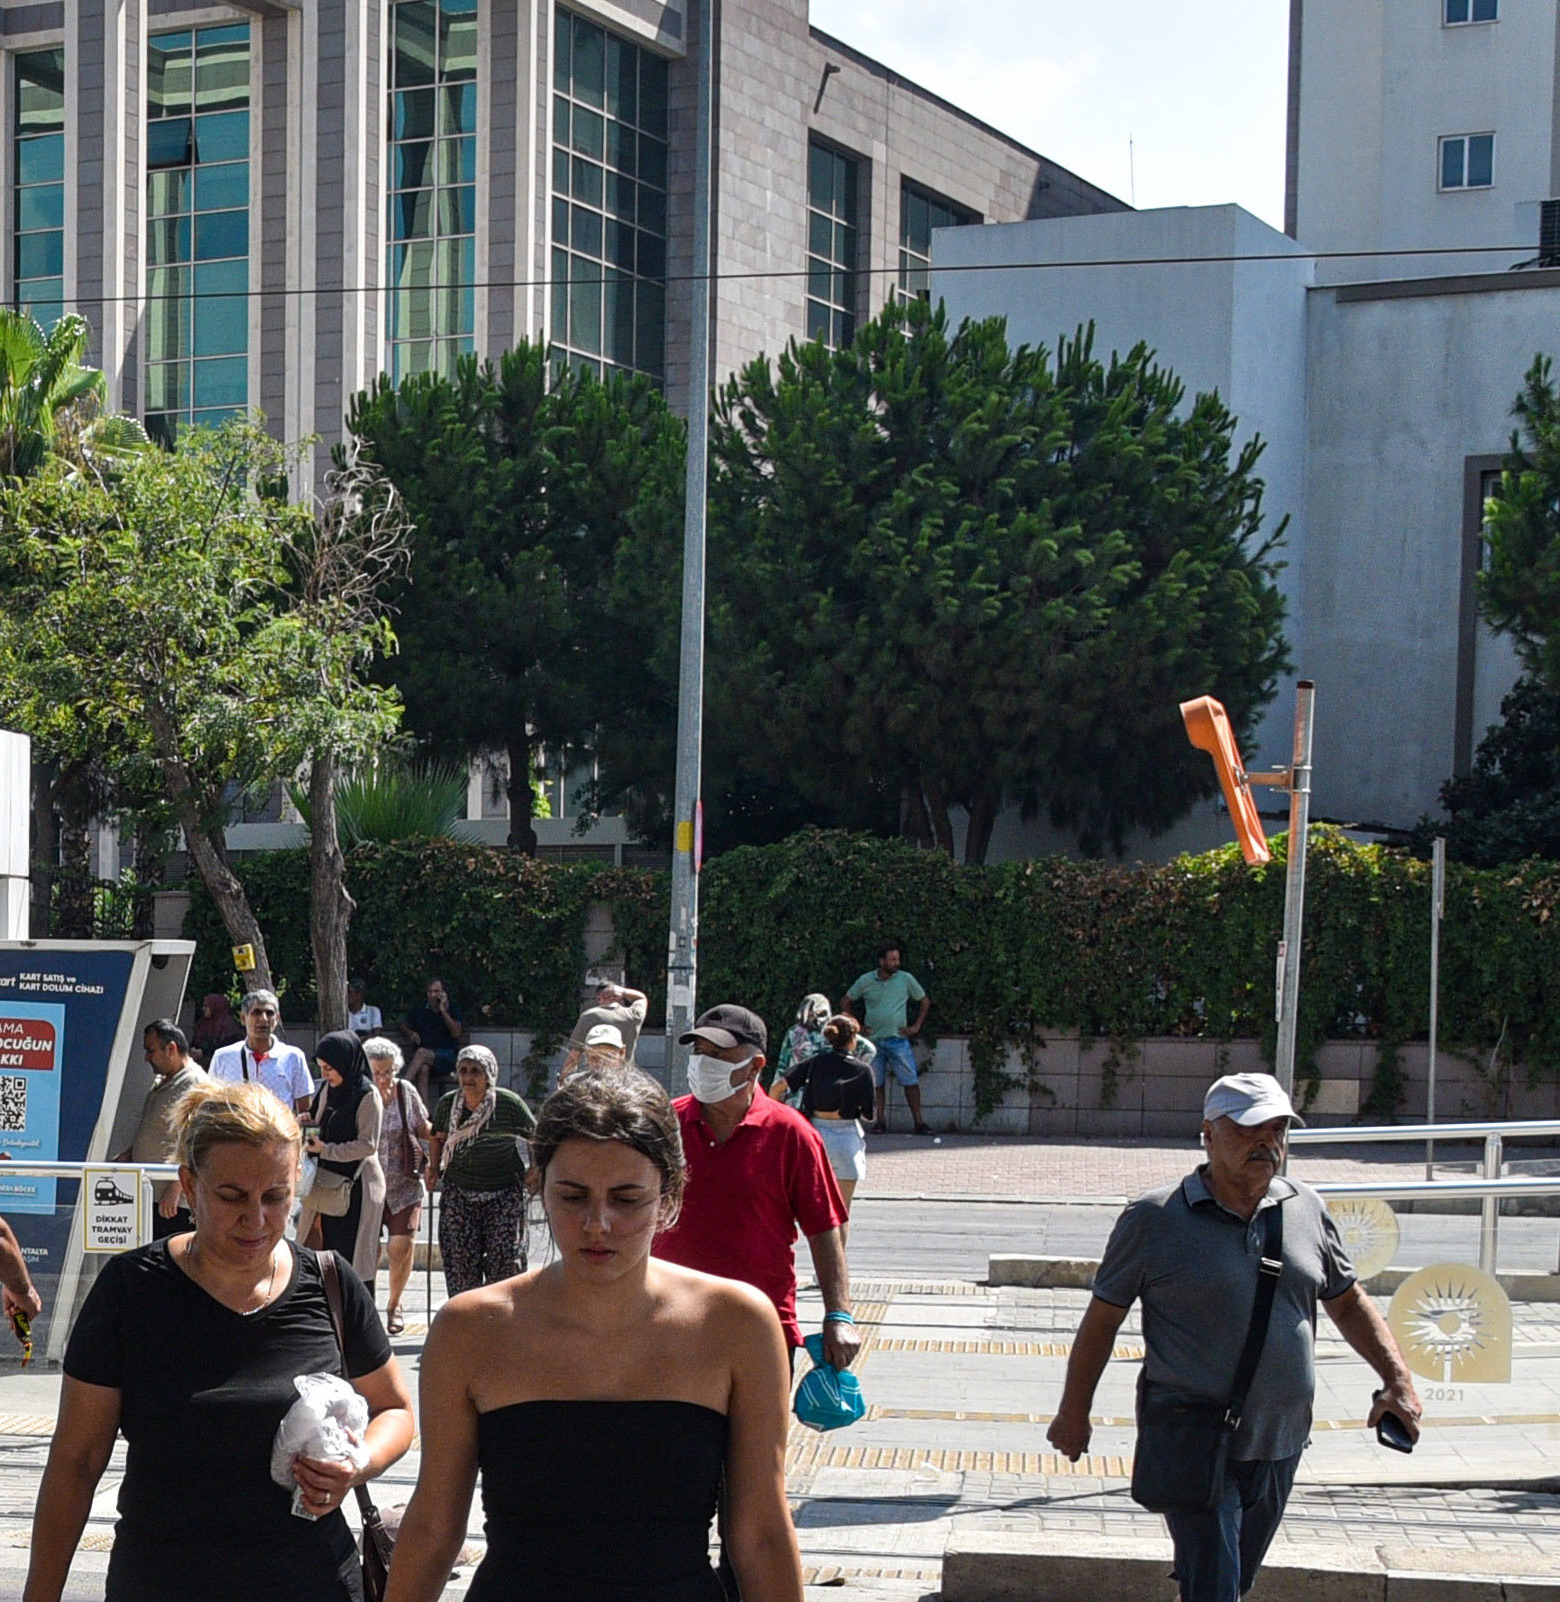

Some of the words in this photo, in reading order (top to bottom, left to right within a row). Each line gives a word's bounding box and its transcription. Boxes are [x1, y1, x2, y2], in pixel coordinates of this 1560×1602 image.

[19, 973, 41, 981] KART
[42, 974, 65, 984] SATIŞ
[19, 983, 41, 991] KART
[42, 984, 73, 993] DOLUM
[75, 983, 105, 995] CİHAZI
[95, 1214, 128, 1224] DİKKAT
[91, 1226, 133, 1235] TRAMVAY
[20, 1247, 49, 1256] NTALYA
[1425, 1387, 1464, 1402] 2021
